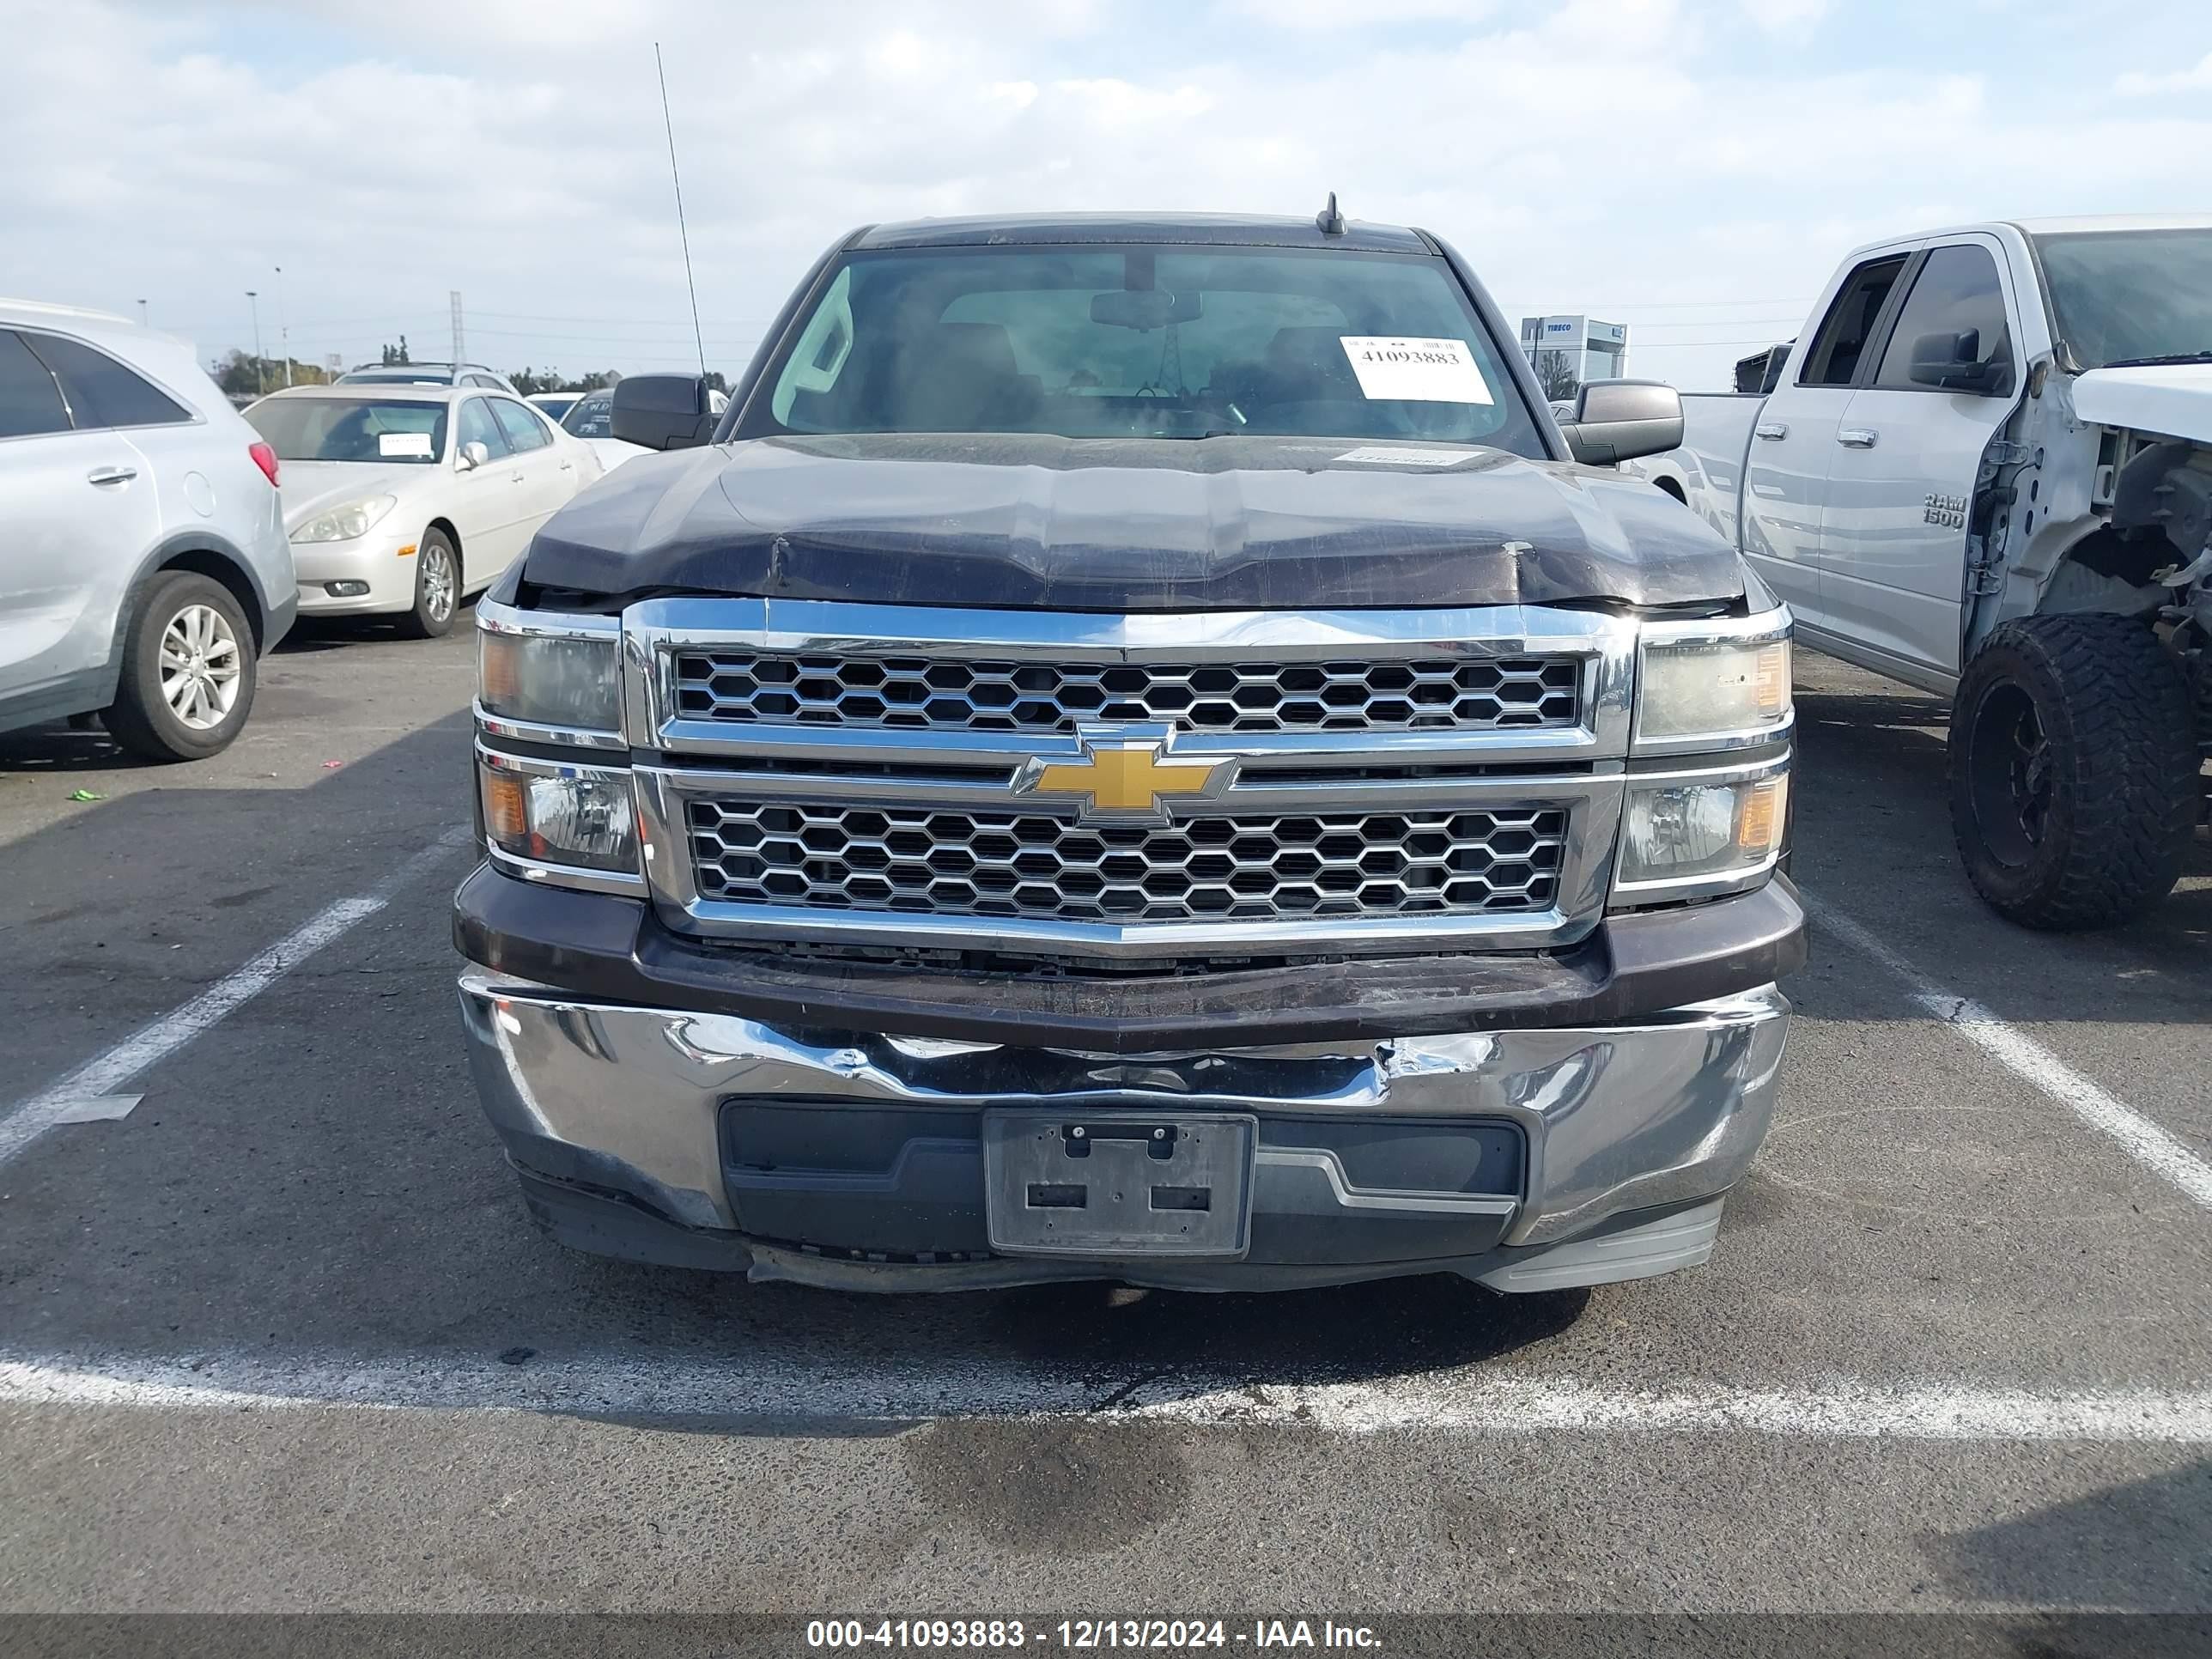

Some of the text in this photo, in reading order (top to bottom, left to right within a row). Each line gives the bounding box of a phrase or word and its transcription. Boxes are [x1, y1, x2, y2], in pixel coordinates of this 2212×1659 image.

[1547, 323, 1571, 332] TIRECO
[1362, 350, 1460, 365] 41093883
[1925, 494, 1966, 513] RAM
[1923, 508, 1965, 529] 1500
